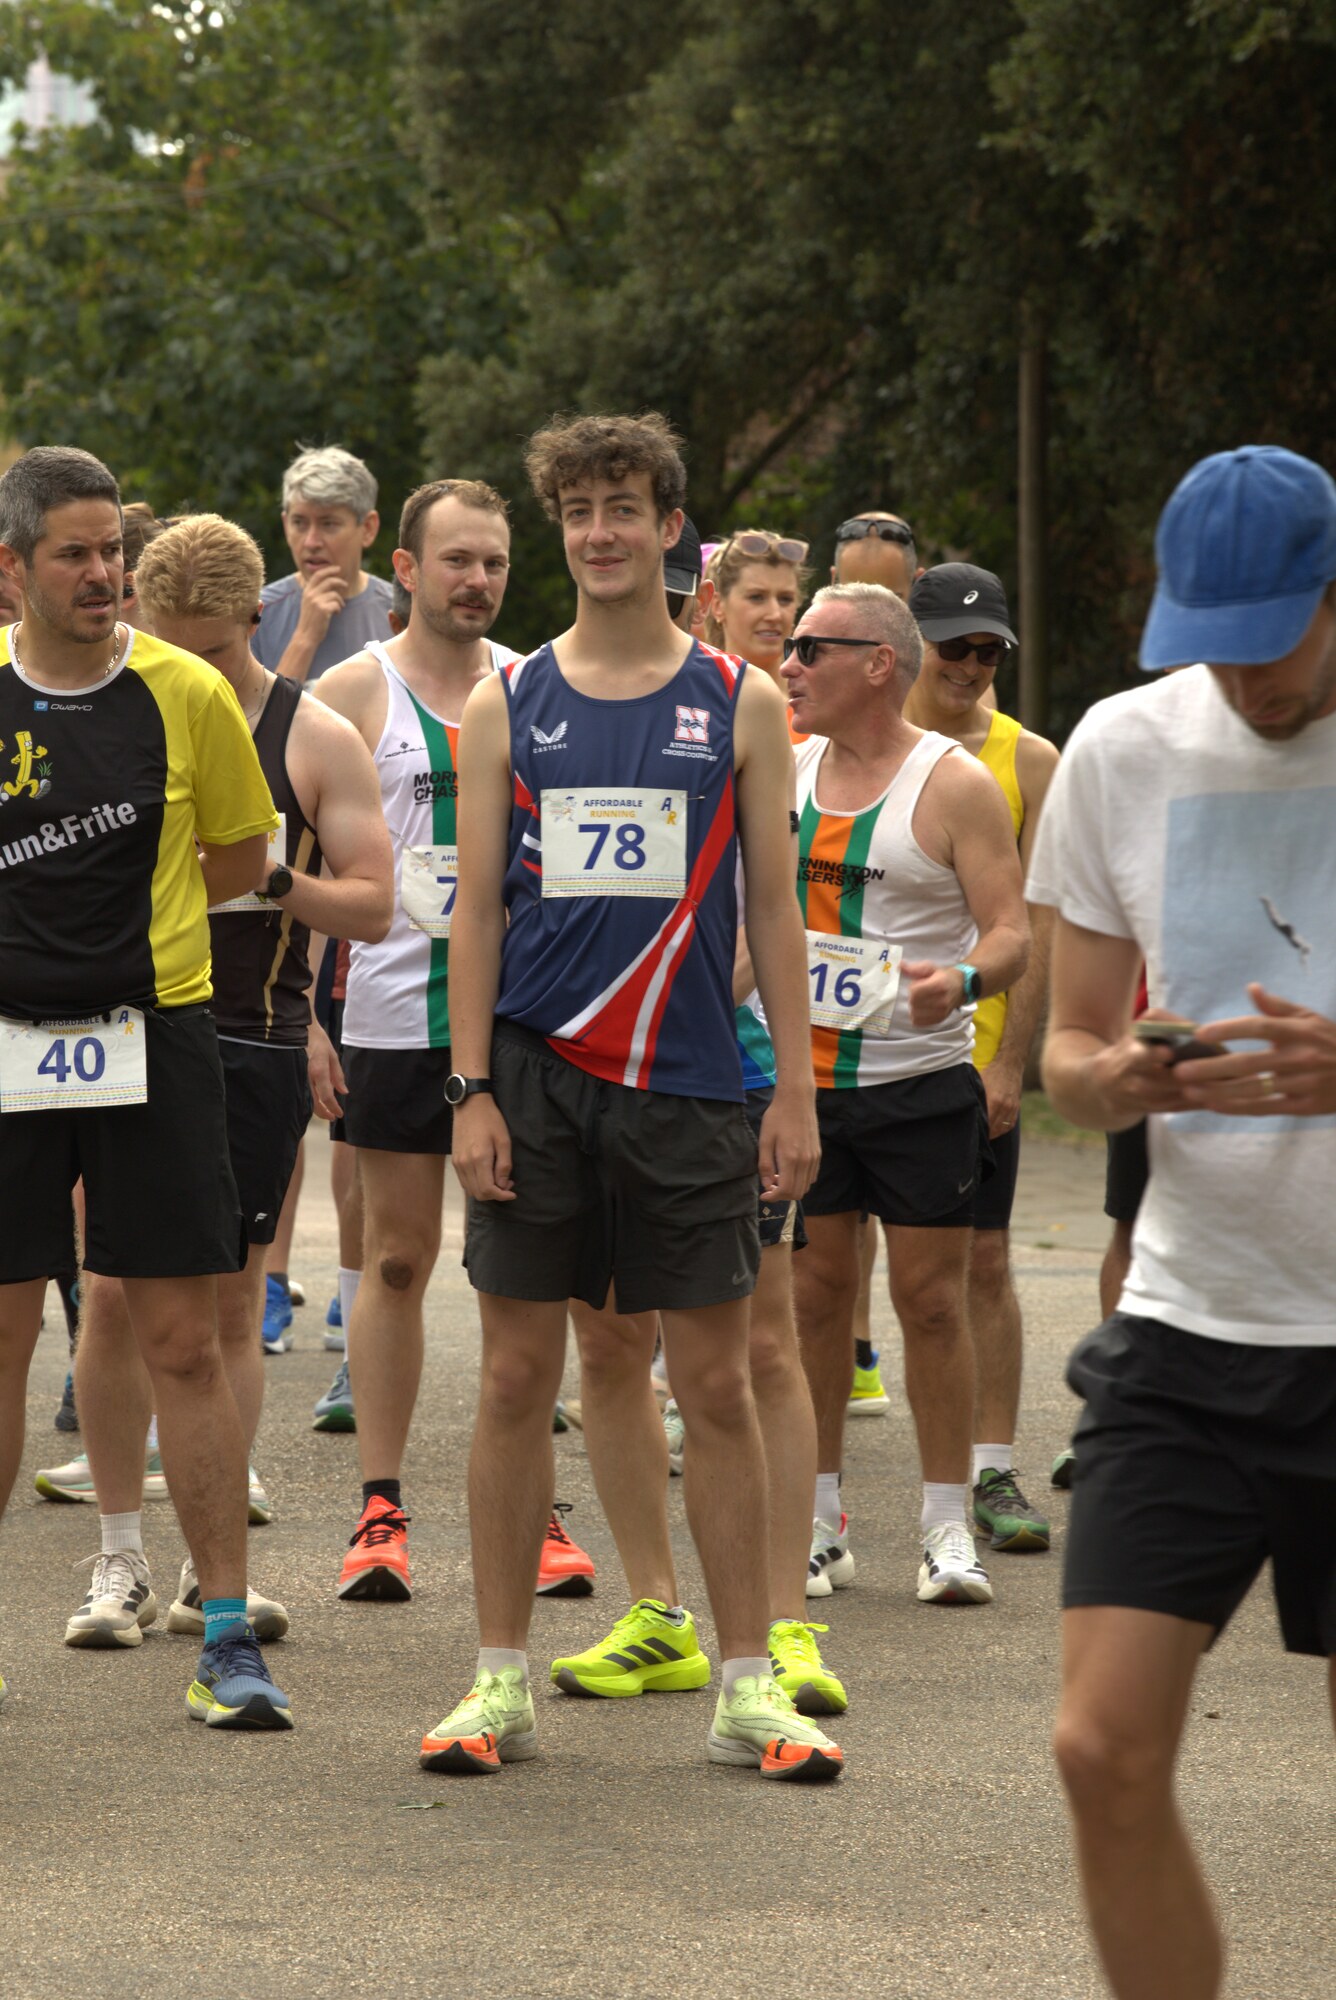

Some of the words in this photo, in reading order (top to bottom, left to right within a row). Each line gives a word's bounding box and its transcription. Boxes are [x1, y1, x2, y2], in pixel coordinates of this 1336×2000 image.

[533, 743, 568, 753] CASTORE
[583, 799, 644, 808] AFFORDABLE
[590, 810, 636, 818] RUNNING
[578, 823, 646, 871] 78
[814, 941, 864, 955] AFFORDABLE
[818, 951, 857, 963] RUNNING
[809, 963, 862, 1008] 16
[42, 1017, 100, 1027] AFFORDABLE
[48, 1027, 94, 1036] RUNNING
[37, 1036, 106, 1083] 40
